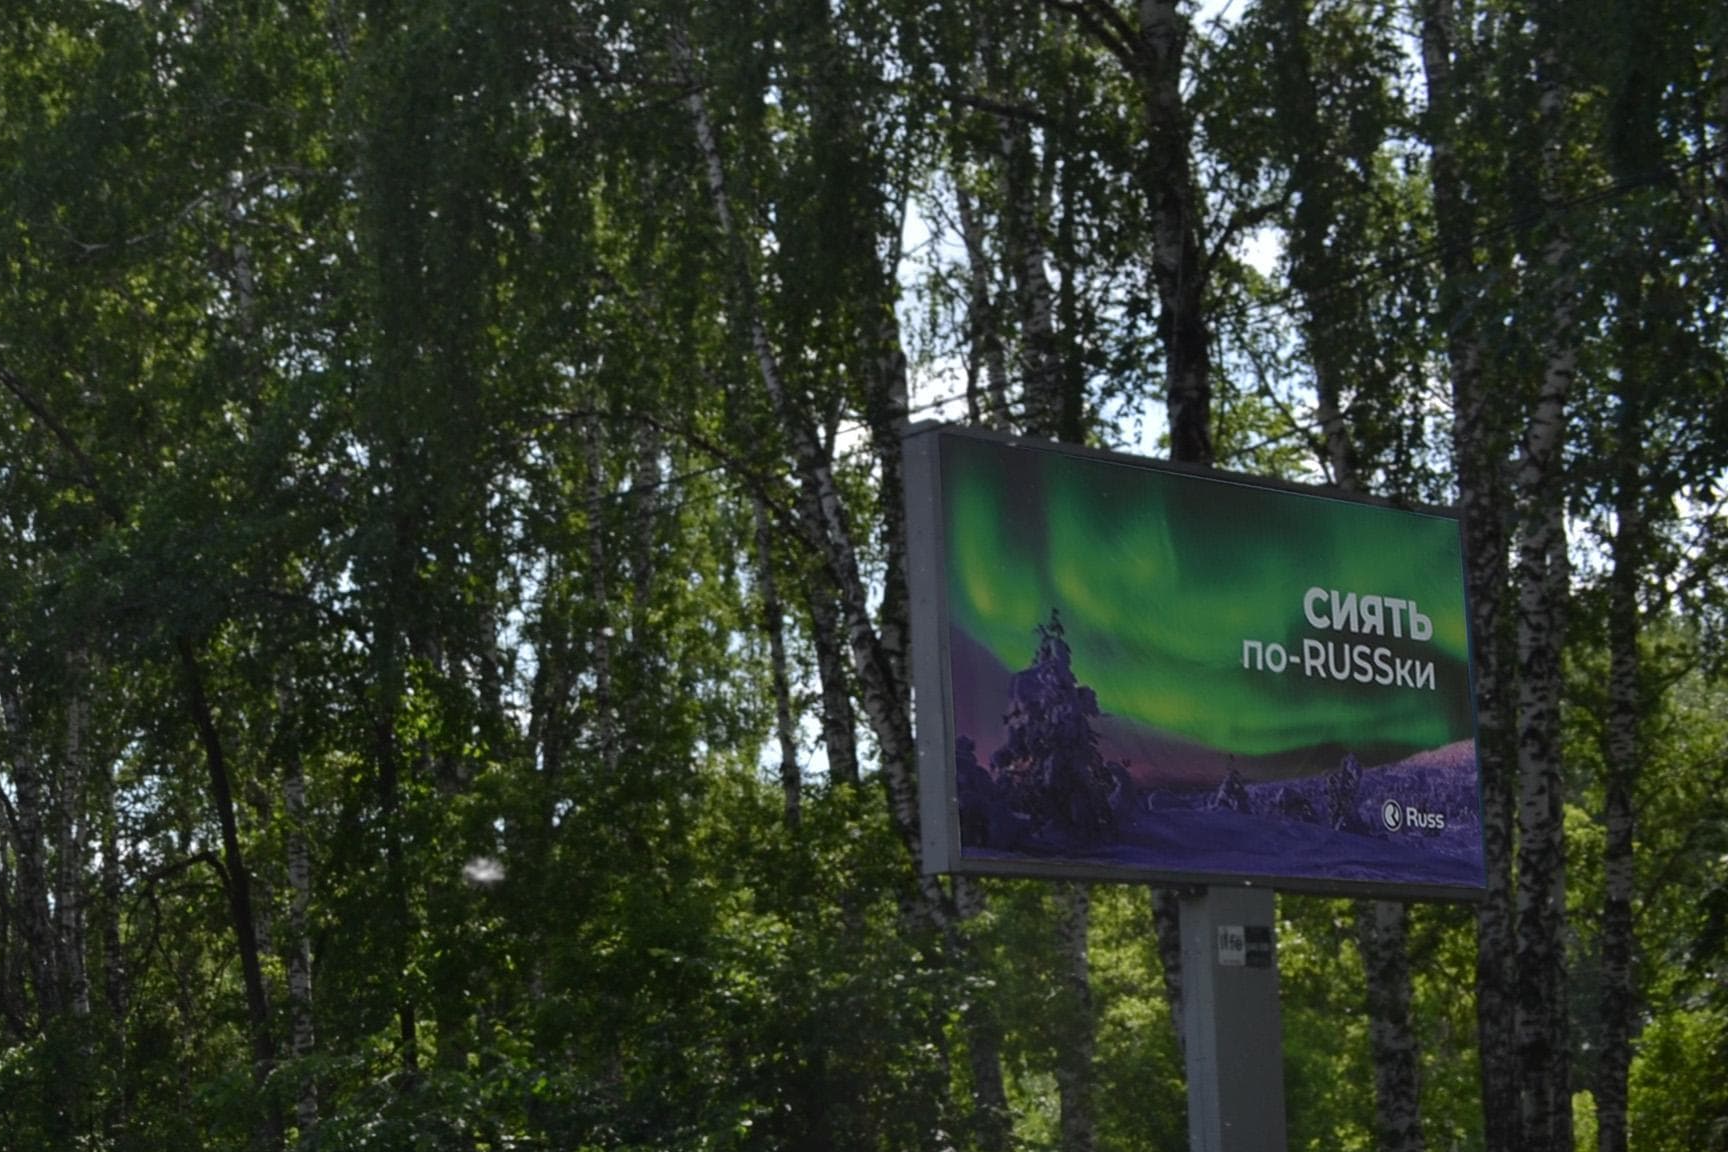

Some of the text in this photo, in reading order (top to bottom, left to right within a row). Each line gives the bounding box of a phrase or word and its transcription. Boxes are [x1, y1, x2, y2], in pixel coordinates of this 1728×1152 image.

[1303, 587, 1433, 641] СИЯТЬ
[1242, 637, 1436, 690] по-RUSSки
[1405, 806, 1445, 829] Russ
